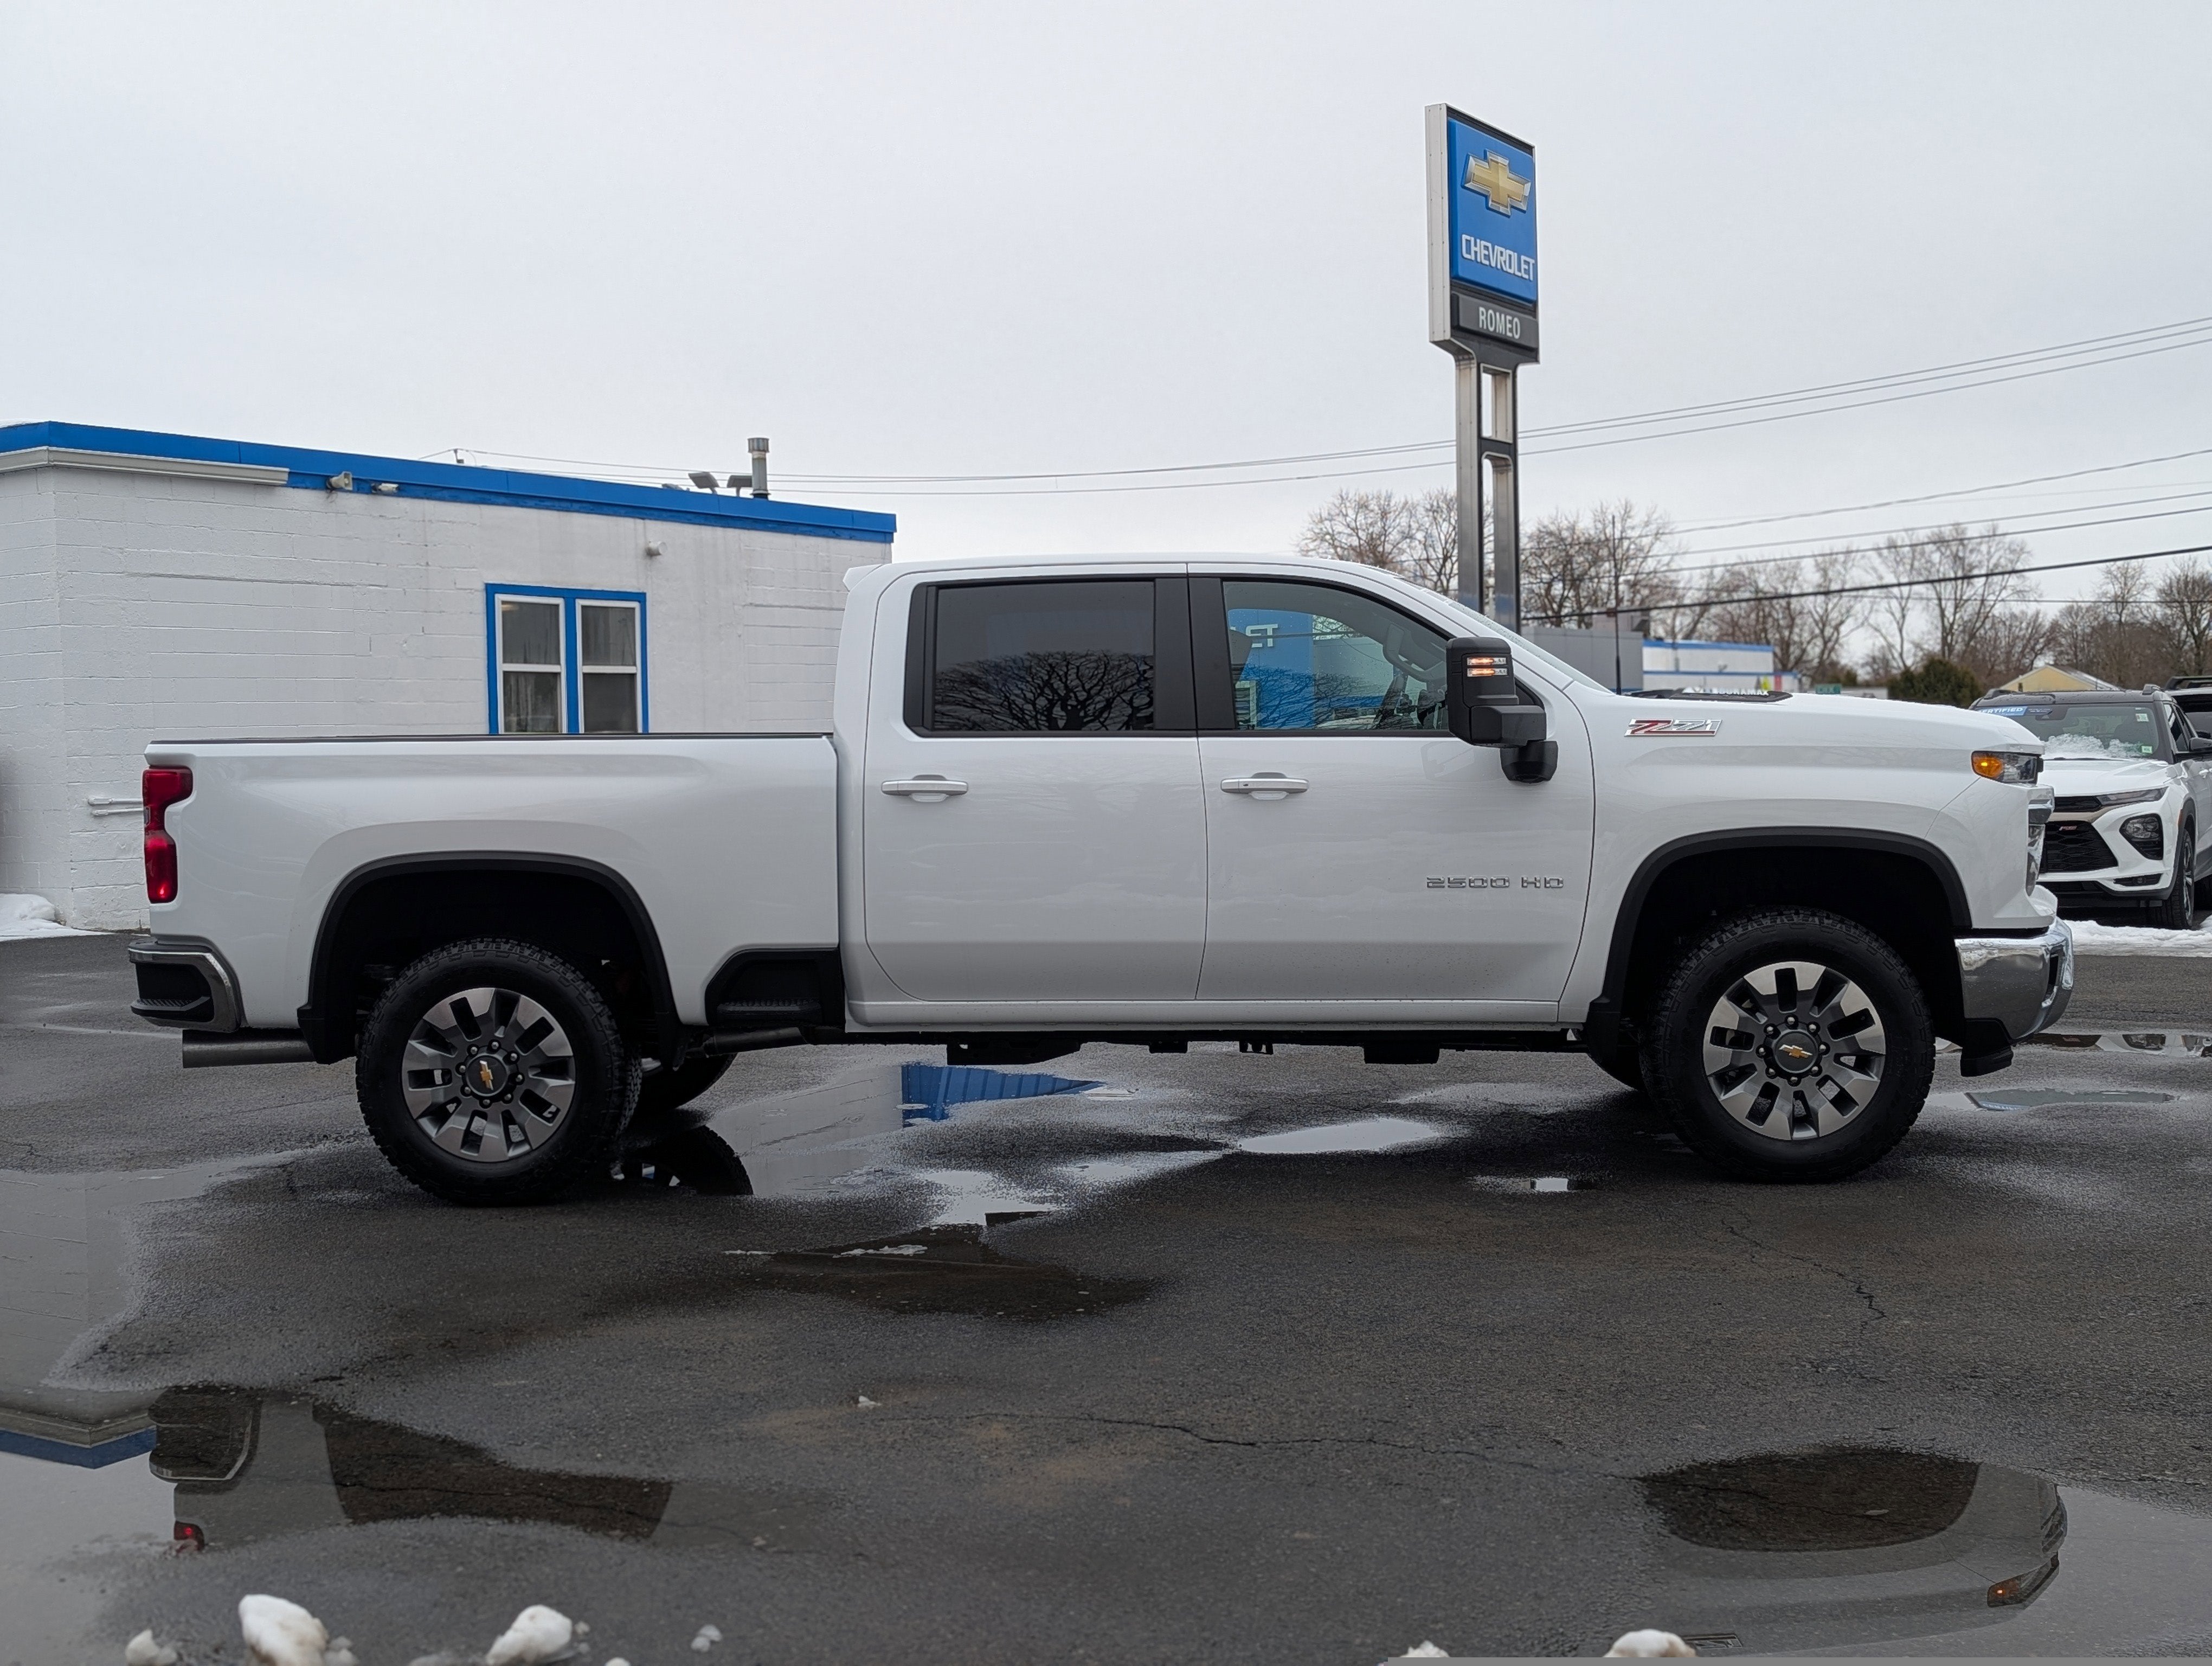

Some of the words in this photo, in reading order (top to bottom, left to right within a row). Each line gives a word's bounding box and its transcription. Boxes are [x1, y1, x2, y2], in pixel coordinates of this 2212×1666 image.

[1462, 234, 1535, 281] CHEVROLET
[1478, 306, 1520, 339] ROMEO
[1624, 718, 1722, 736] Z71
[1426, 876, 1509, 888] 2500
[1521, 876, 1564, 888] HD
